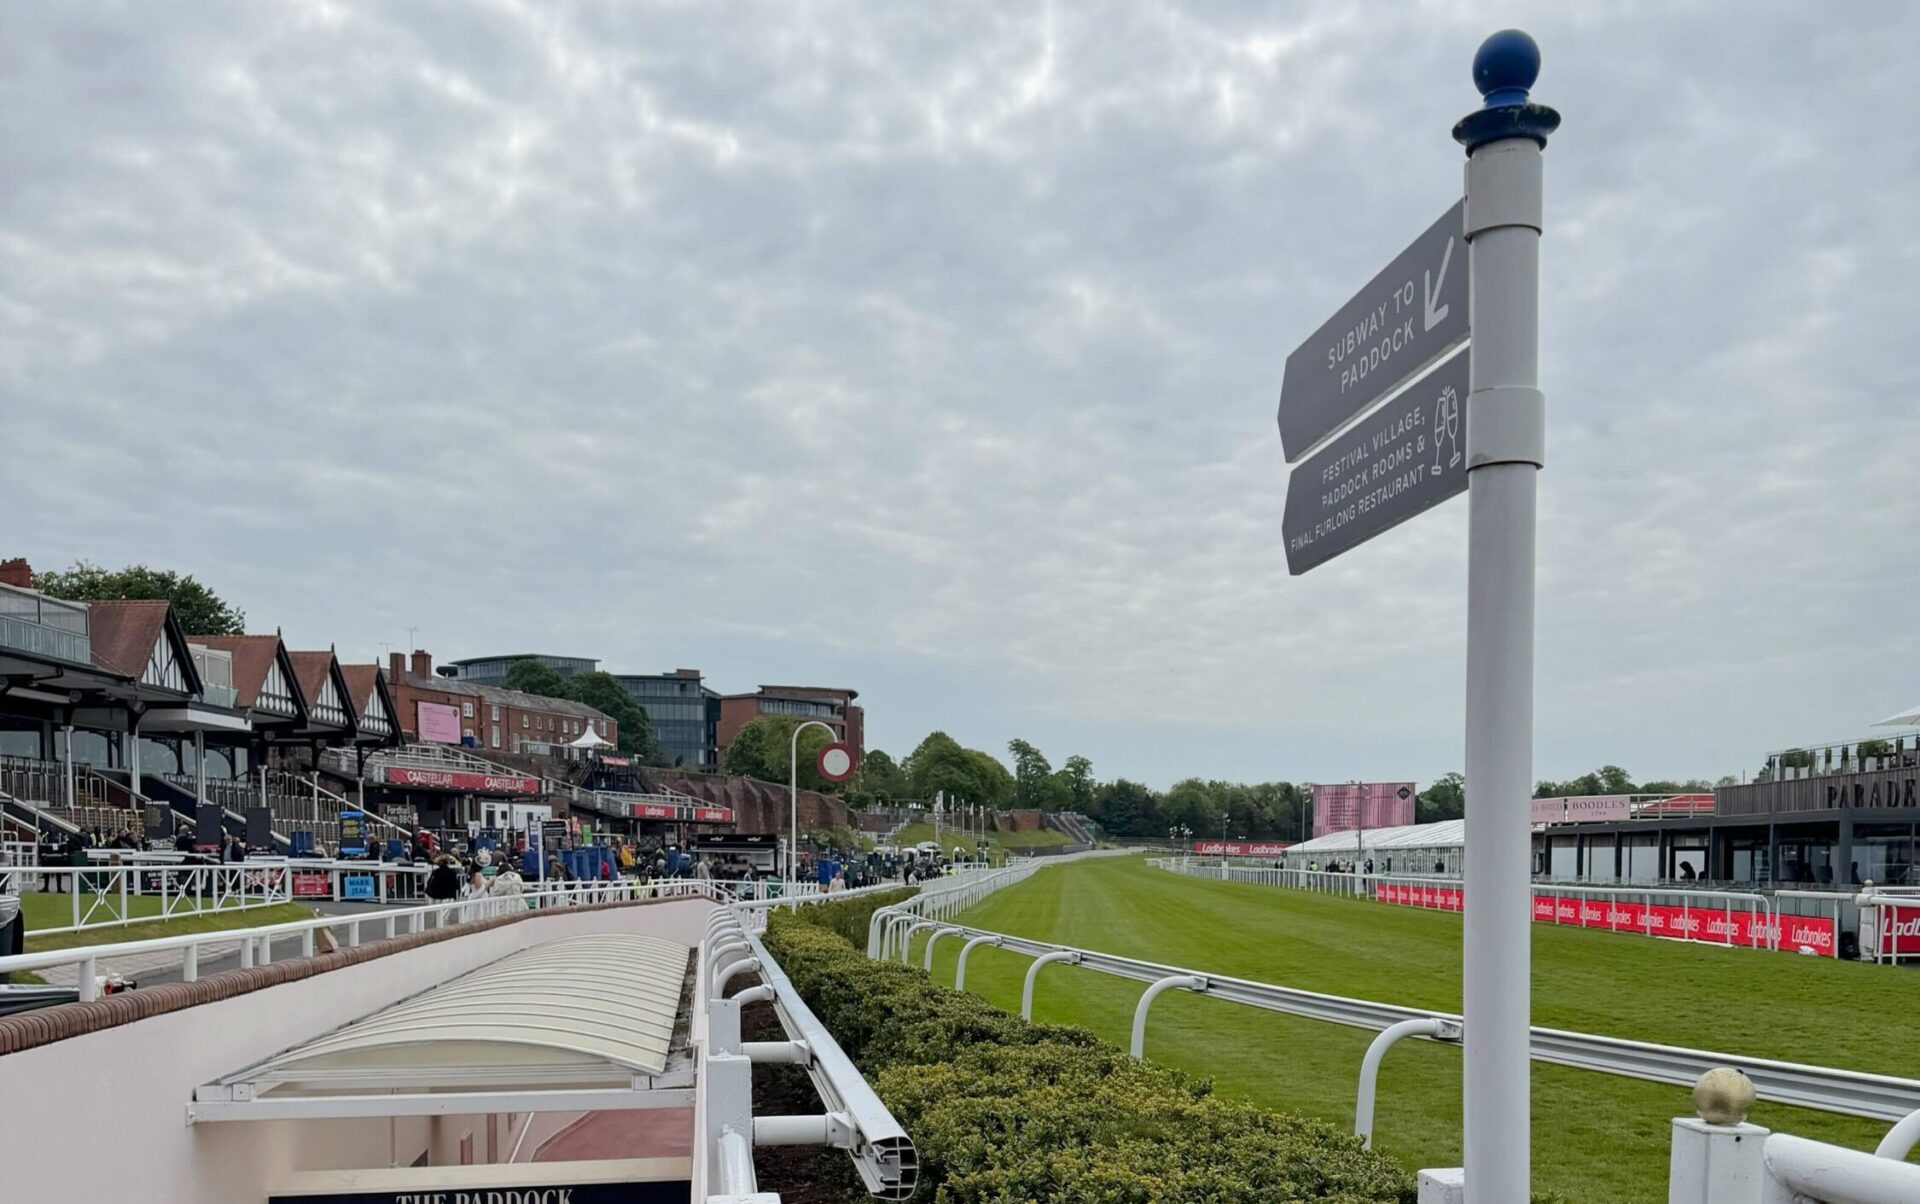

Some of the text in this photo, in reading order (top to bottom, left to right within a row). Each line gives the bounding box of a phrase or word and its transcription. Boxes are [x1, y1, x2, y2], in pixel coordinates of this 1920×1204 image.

[1327, 280, 1415, 370] SUBWAY TO
[1341, 317, 1415, 394] PADDOCK
[1322, 406, 1426, 485] FESTIVAL VILLAGE,
[1322, 435, 1426, 511] PADDOCK ROOMS &
[1290, 463, 1425, 554] FINAL FURLONG RESTAURANT
[1572, 800, 1625, 810] BOODLES
[1827, 778, 1916, 809] PARADE
[1249, 844, 1284, 855] Ladbroke
[1579, 905, 1602, 921] Ldbrokes
[1606, 908, 1632, 925] Labrokes
[1637, 911, 1665, 928] Ladrokes
[1706, 916, 1740, 937] Ladbroes
[1791, 924, 1832, 948] Ladbrokes
